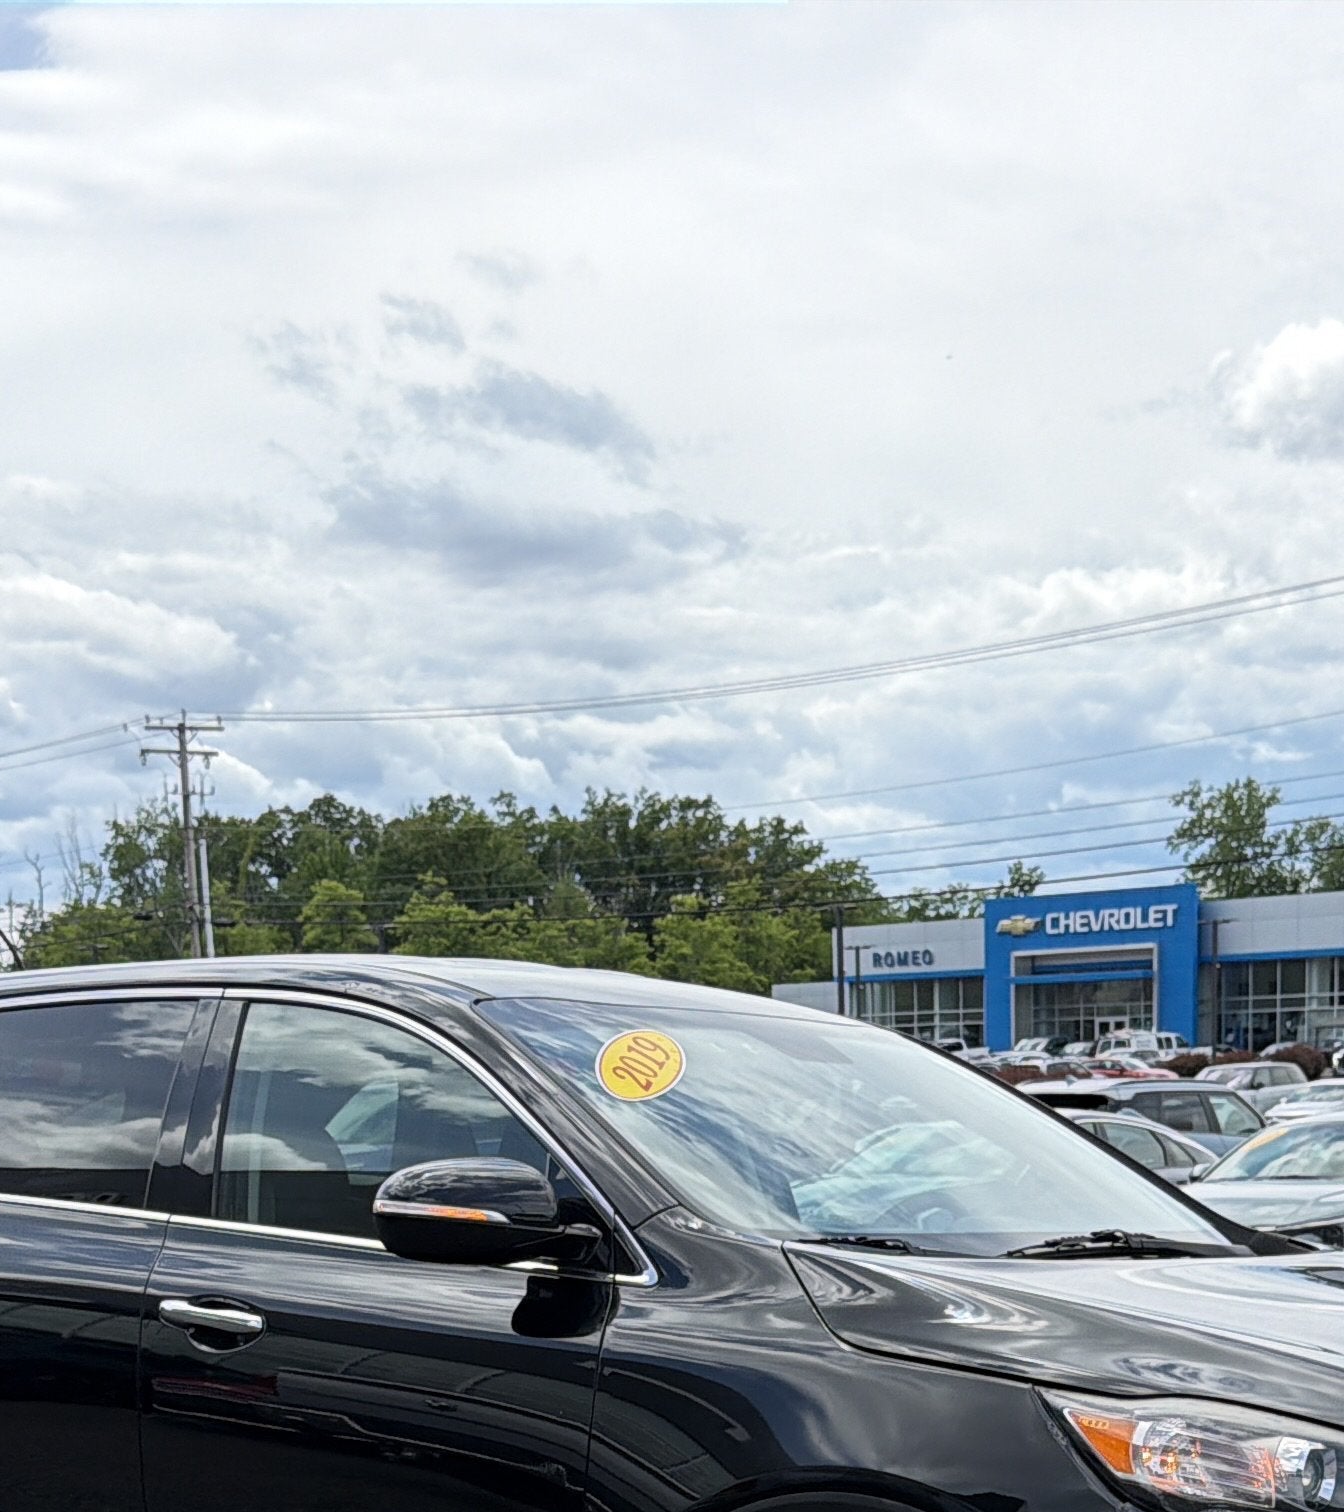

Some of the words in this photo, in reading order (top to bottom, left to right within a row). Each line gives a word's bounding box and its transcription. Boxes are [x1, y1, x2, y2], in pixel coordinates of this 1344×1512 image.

[1045, 904, 1178, 935] CHEVROLET
[872, 949, 934, 968] ROMEO
[612, 1036, 670, 1092] 2019
